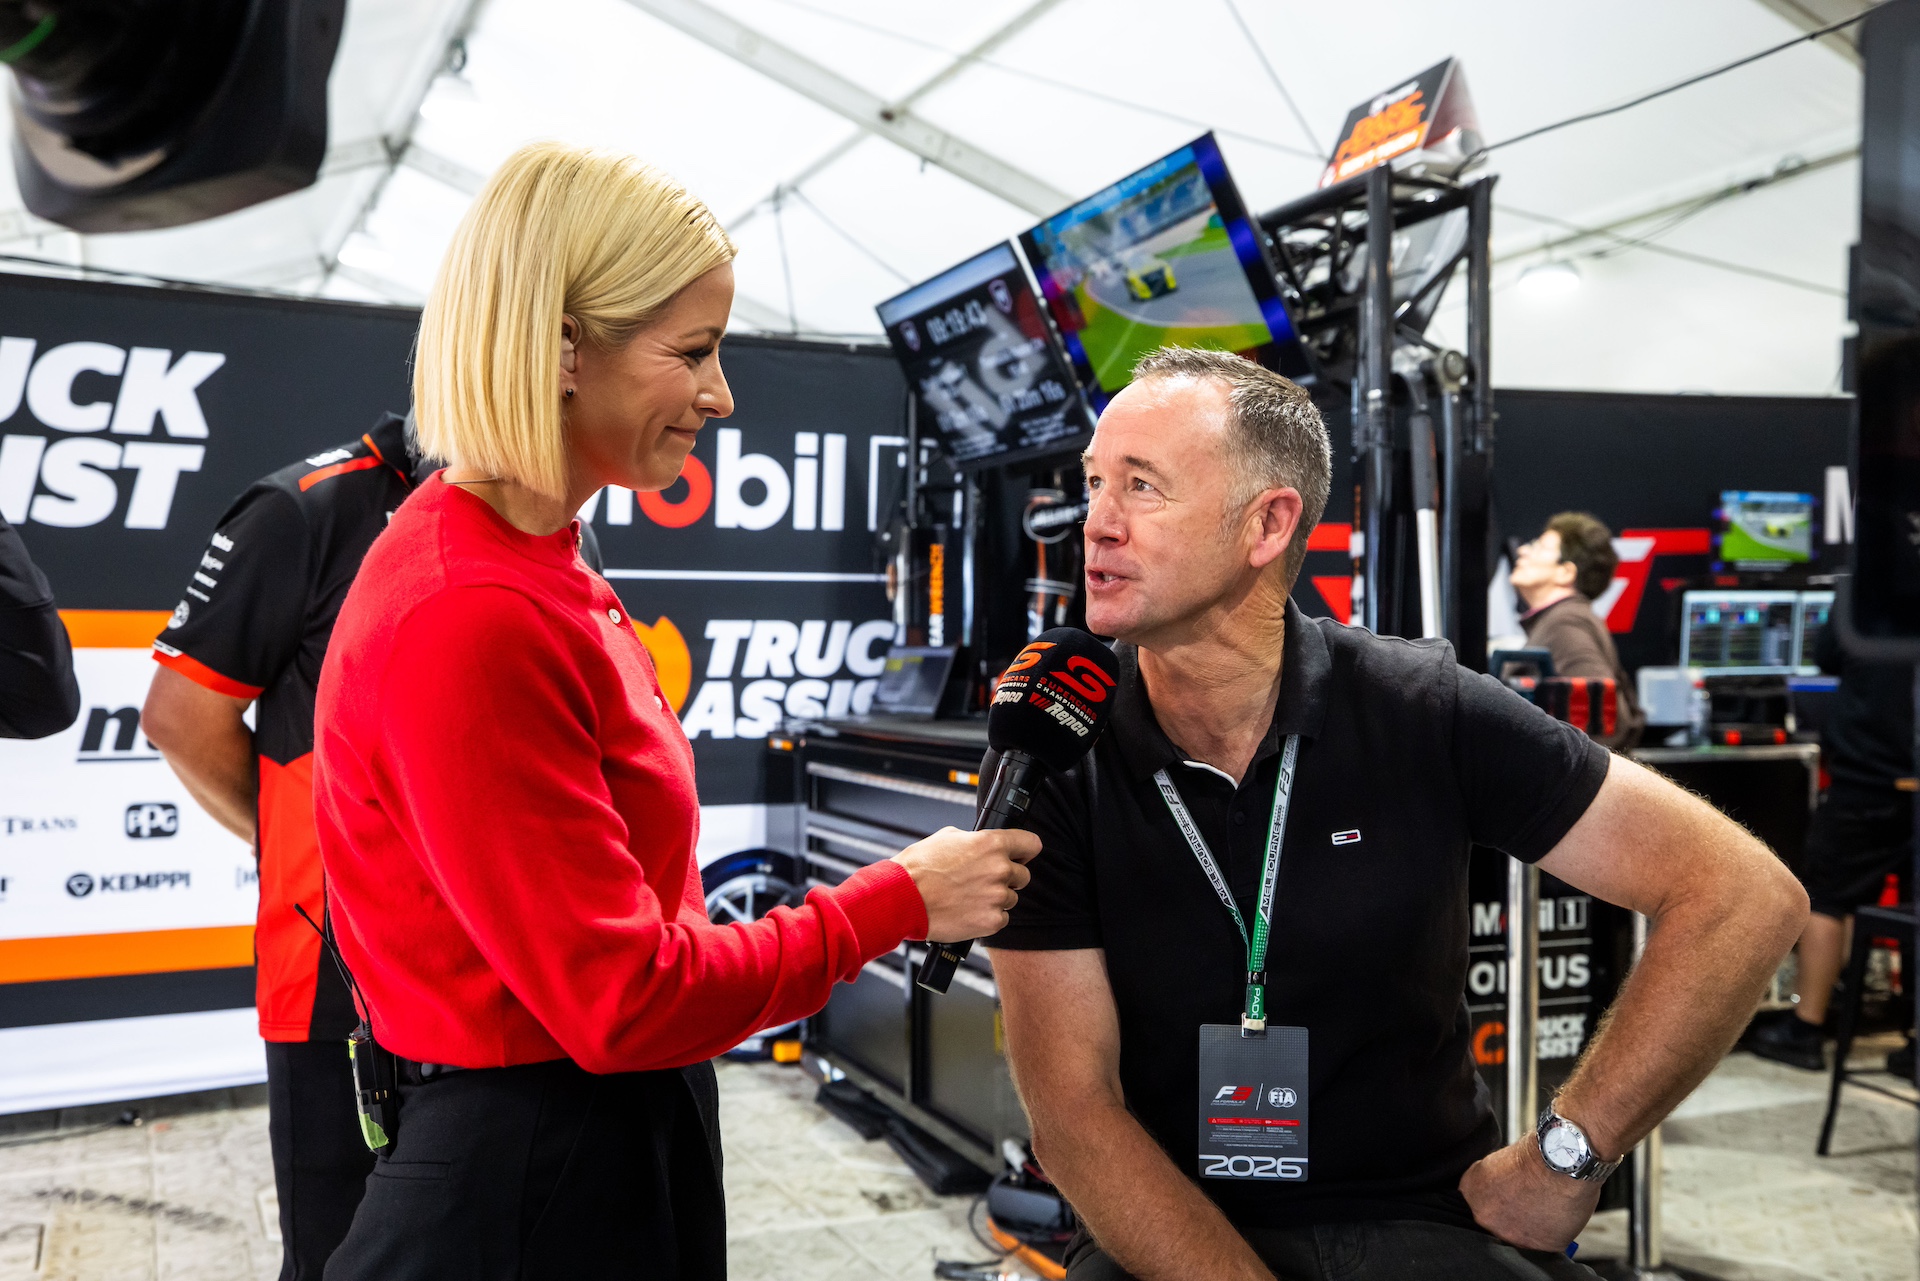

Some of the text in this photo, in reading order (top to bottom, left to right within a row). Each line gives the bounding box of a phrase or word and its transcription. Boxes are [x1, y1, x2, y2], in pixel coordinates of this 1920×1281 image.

[704, 619, 906, 678] TRUC
[1036, 682, 1094, 725] CHAMPIONSHIP
[1040, 677, 1097, 720] SUPERCARS
[1044, 701, 1090, 737] Repco
[1278, 771, 1291, 796] F3
[100, 871, 191, 892] KEMPPI
[1183, 824, 1229, 901] MELBOURNE
[1262, 824, 1281, 908] MELBOURNE
[1472, 898, 1555, 936] Mil
[1468, 953, 1591, 995] OUS
[1214, 1085, 1254, 1101] F3
[1199, 1154, 1309, 1179] 2026
